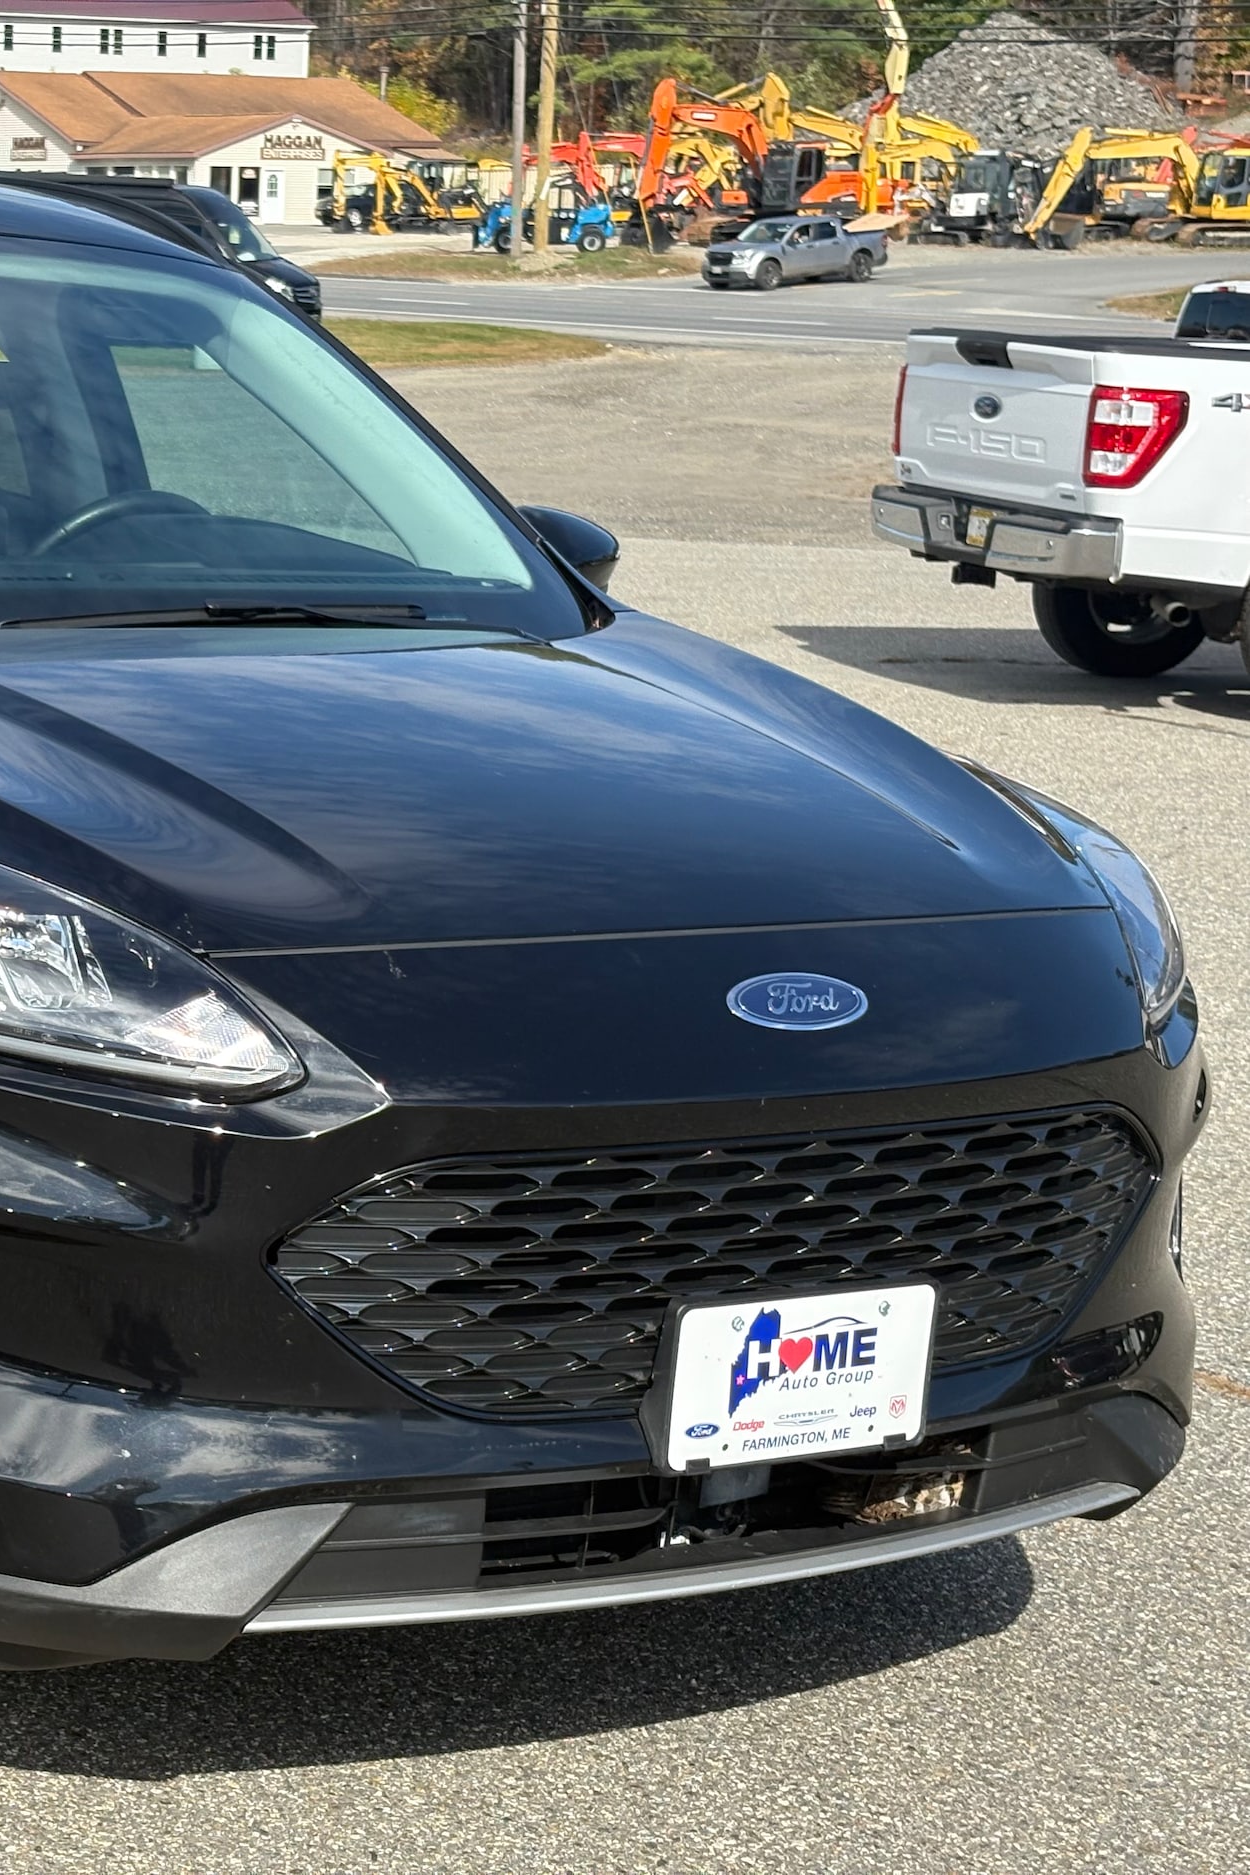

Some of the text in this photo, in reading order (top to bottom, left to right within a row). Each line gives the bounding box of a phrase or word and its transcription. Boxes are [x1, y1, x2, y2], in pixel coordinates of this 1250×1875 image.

[264, 134, 323, 150] HAGGAN
[262, 149, 323, 160] ENTERPRISES
[926, 422, 1047, 464] F-150
[767, 982, 840, 1015] Ford
[778, 1369, 874, 1392] Auto Group
[778, 1408, 835, 1420] CHRYSLER
[849, 1405, 877, 1418] Jeep
[690, 1425, 714, 1437] Ford
[733, 1419, 765, 1433] Dodge
[742, 1427, 851, 1452] FARMINGTON, ME
